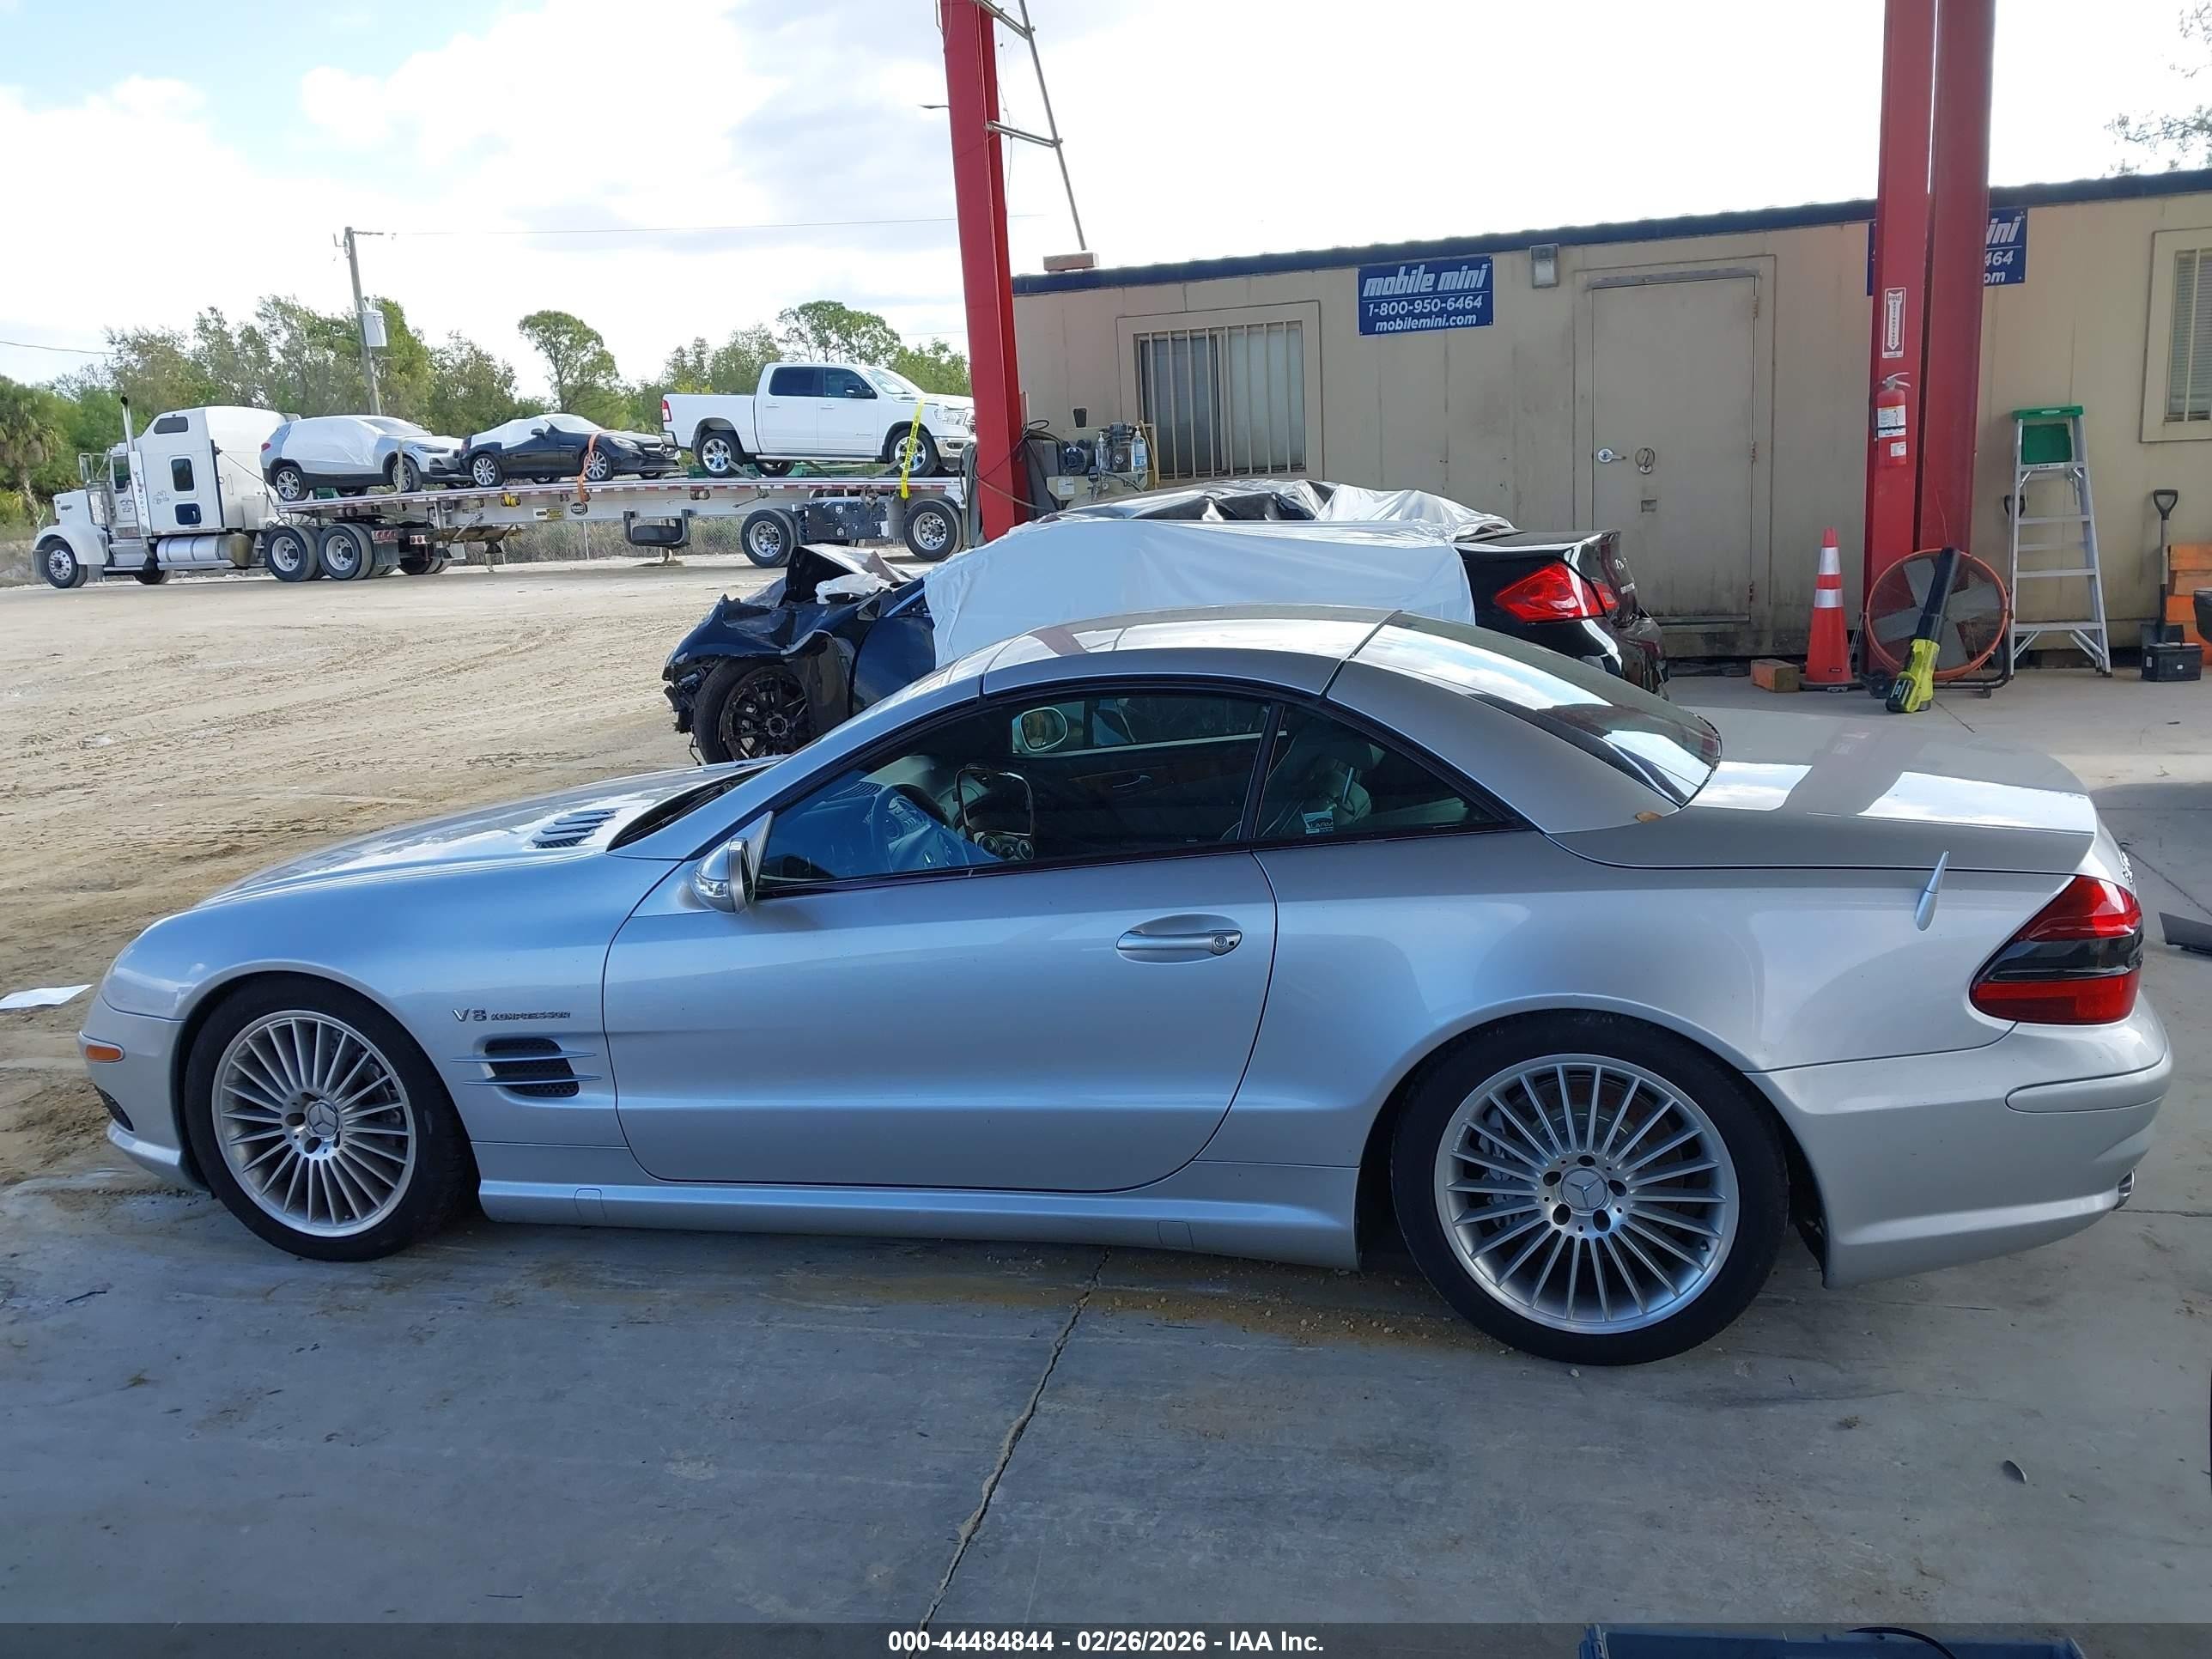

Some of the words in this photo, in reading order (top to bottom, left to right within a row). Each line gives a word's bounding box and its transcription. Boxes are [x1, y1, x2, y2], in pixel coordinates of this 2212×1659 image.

[1985, 216, 2021, 245] ini
[1985, 250, 2014, 266] 464
[1363, 264, 1435, 297] mobile
[1437, 264, 1489, 291] mini
[1984, 271, 2006, 283] om
[1368, 295, 1483, 317] 1-800-950-6464
[1375, 313, 1477, 332] mobilemini.com
[452, 1008, 487, 1022] V8
